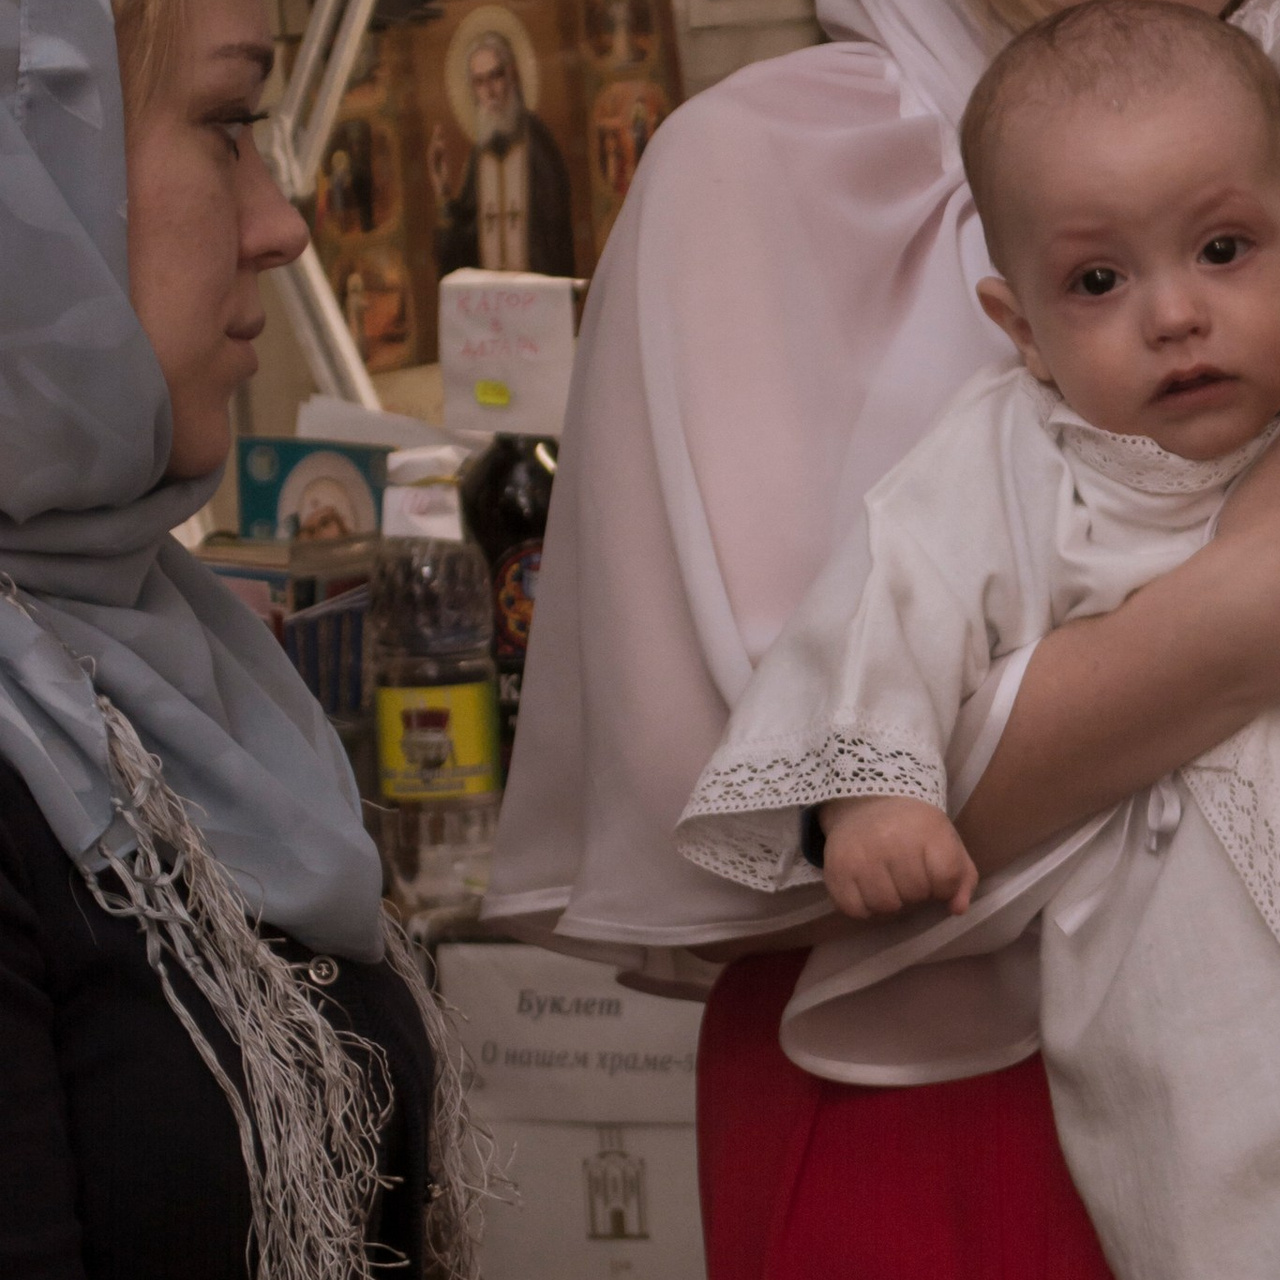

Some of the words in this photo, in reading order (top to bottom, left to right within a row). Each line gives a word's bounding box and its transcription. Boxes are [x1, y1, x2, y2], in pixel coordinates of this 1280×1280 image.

[516, 988, 624, 1022] Буклет
[480, 1039, 499, 1066] О
[503, 1047, 591, 1069] нашем
